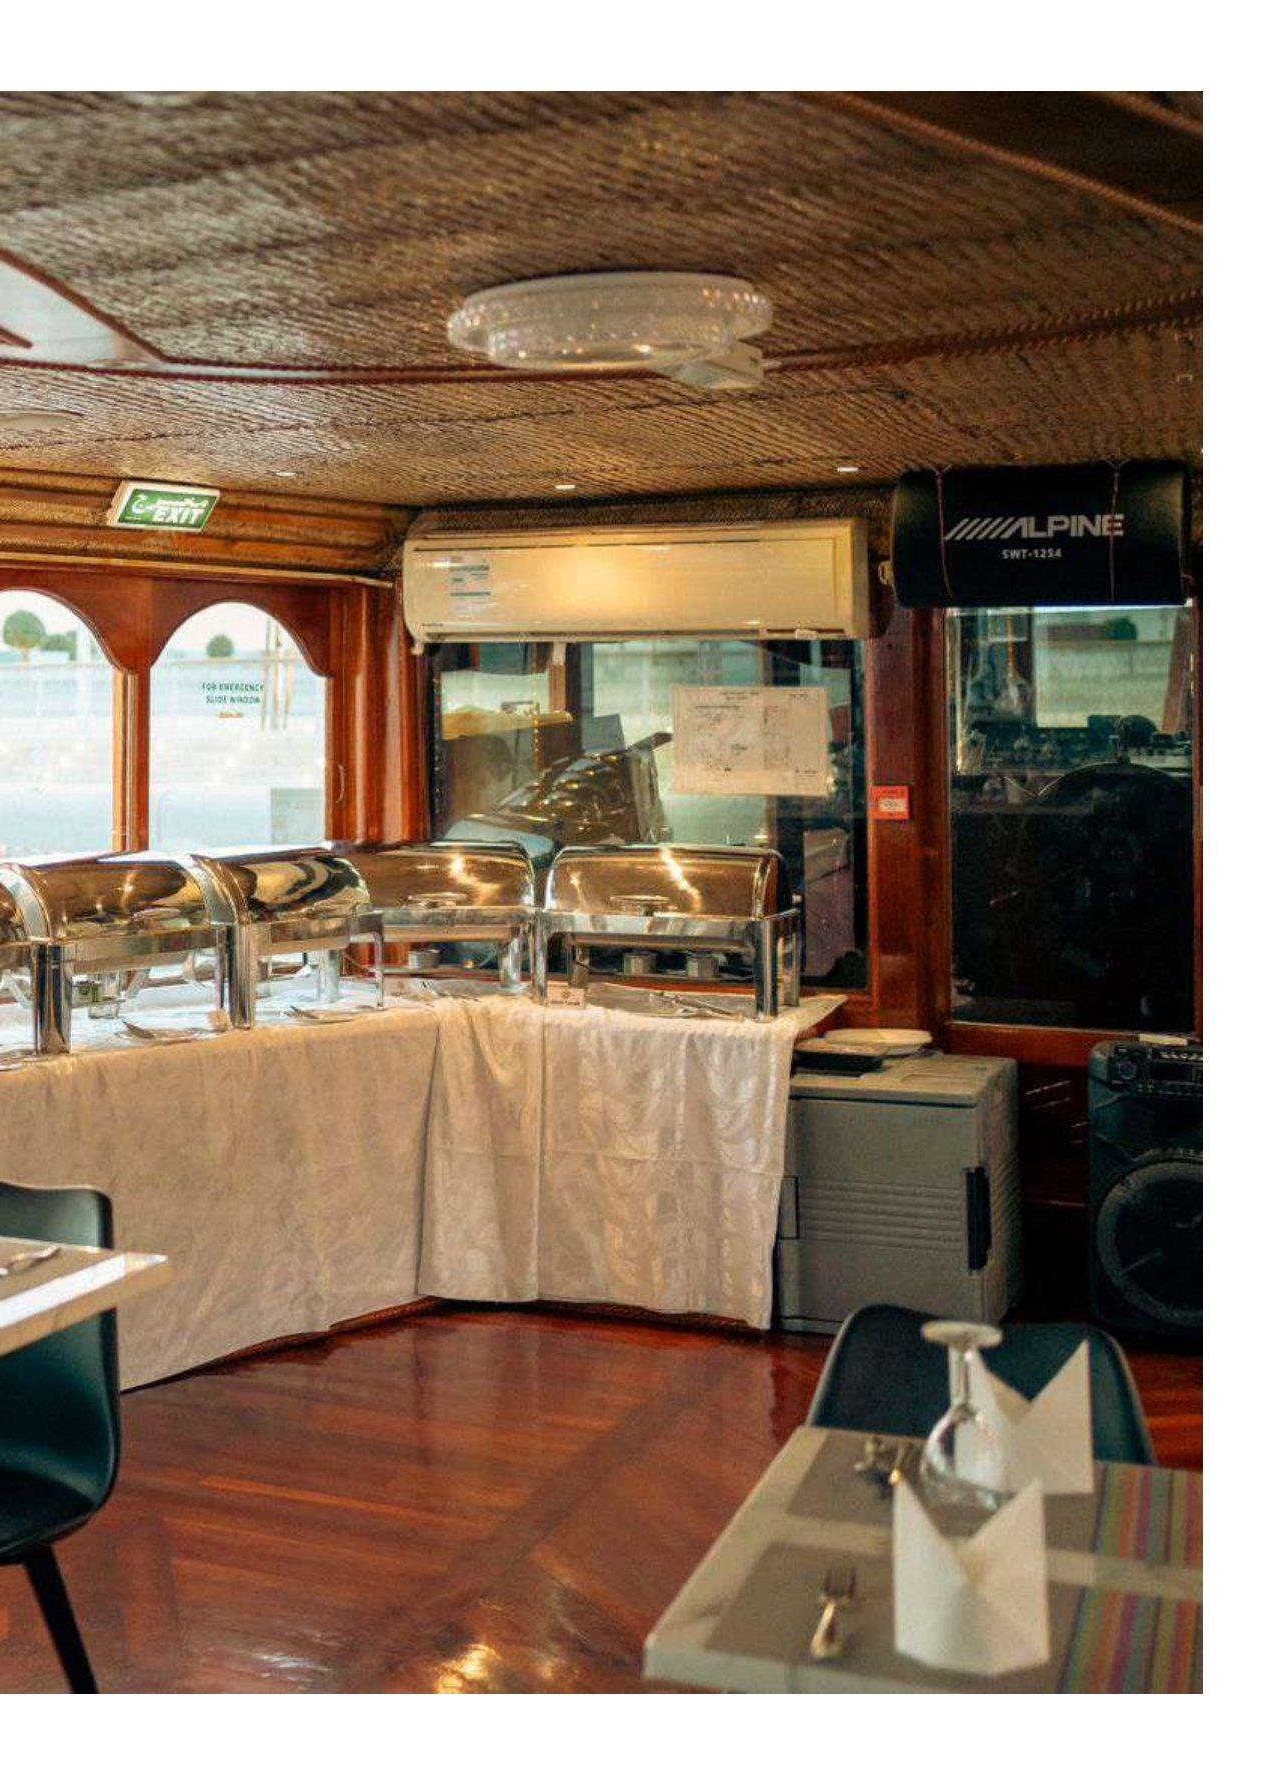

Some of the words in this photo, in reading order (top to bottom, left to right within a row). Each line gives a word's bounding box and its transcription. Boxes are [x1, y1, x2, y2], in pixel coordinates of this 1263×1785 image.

[152, 507, 205, 524] EXIT
[1000, 514, 1125, 539] ALPINE
[202, 682, 217, 691] FOR
[219, 682, 264, 692] EMERGENCY
